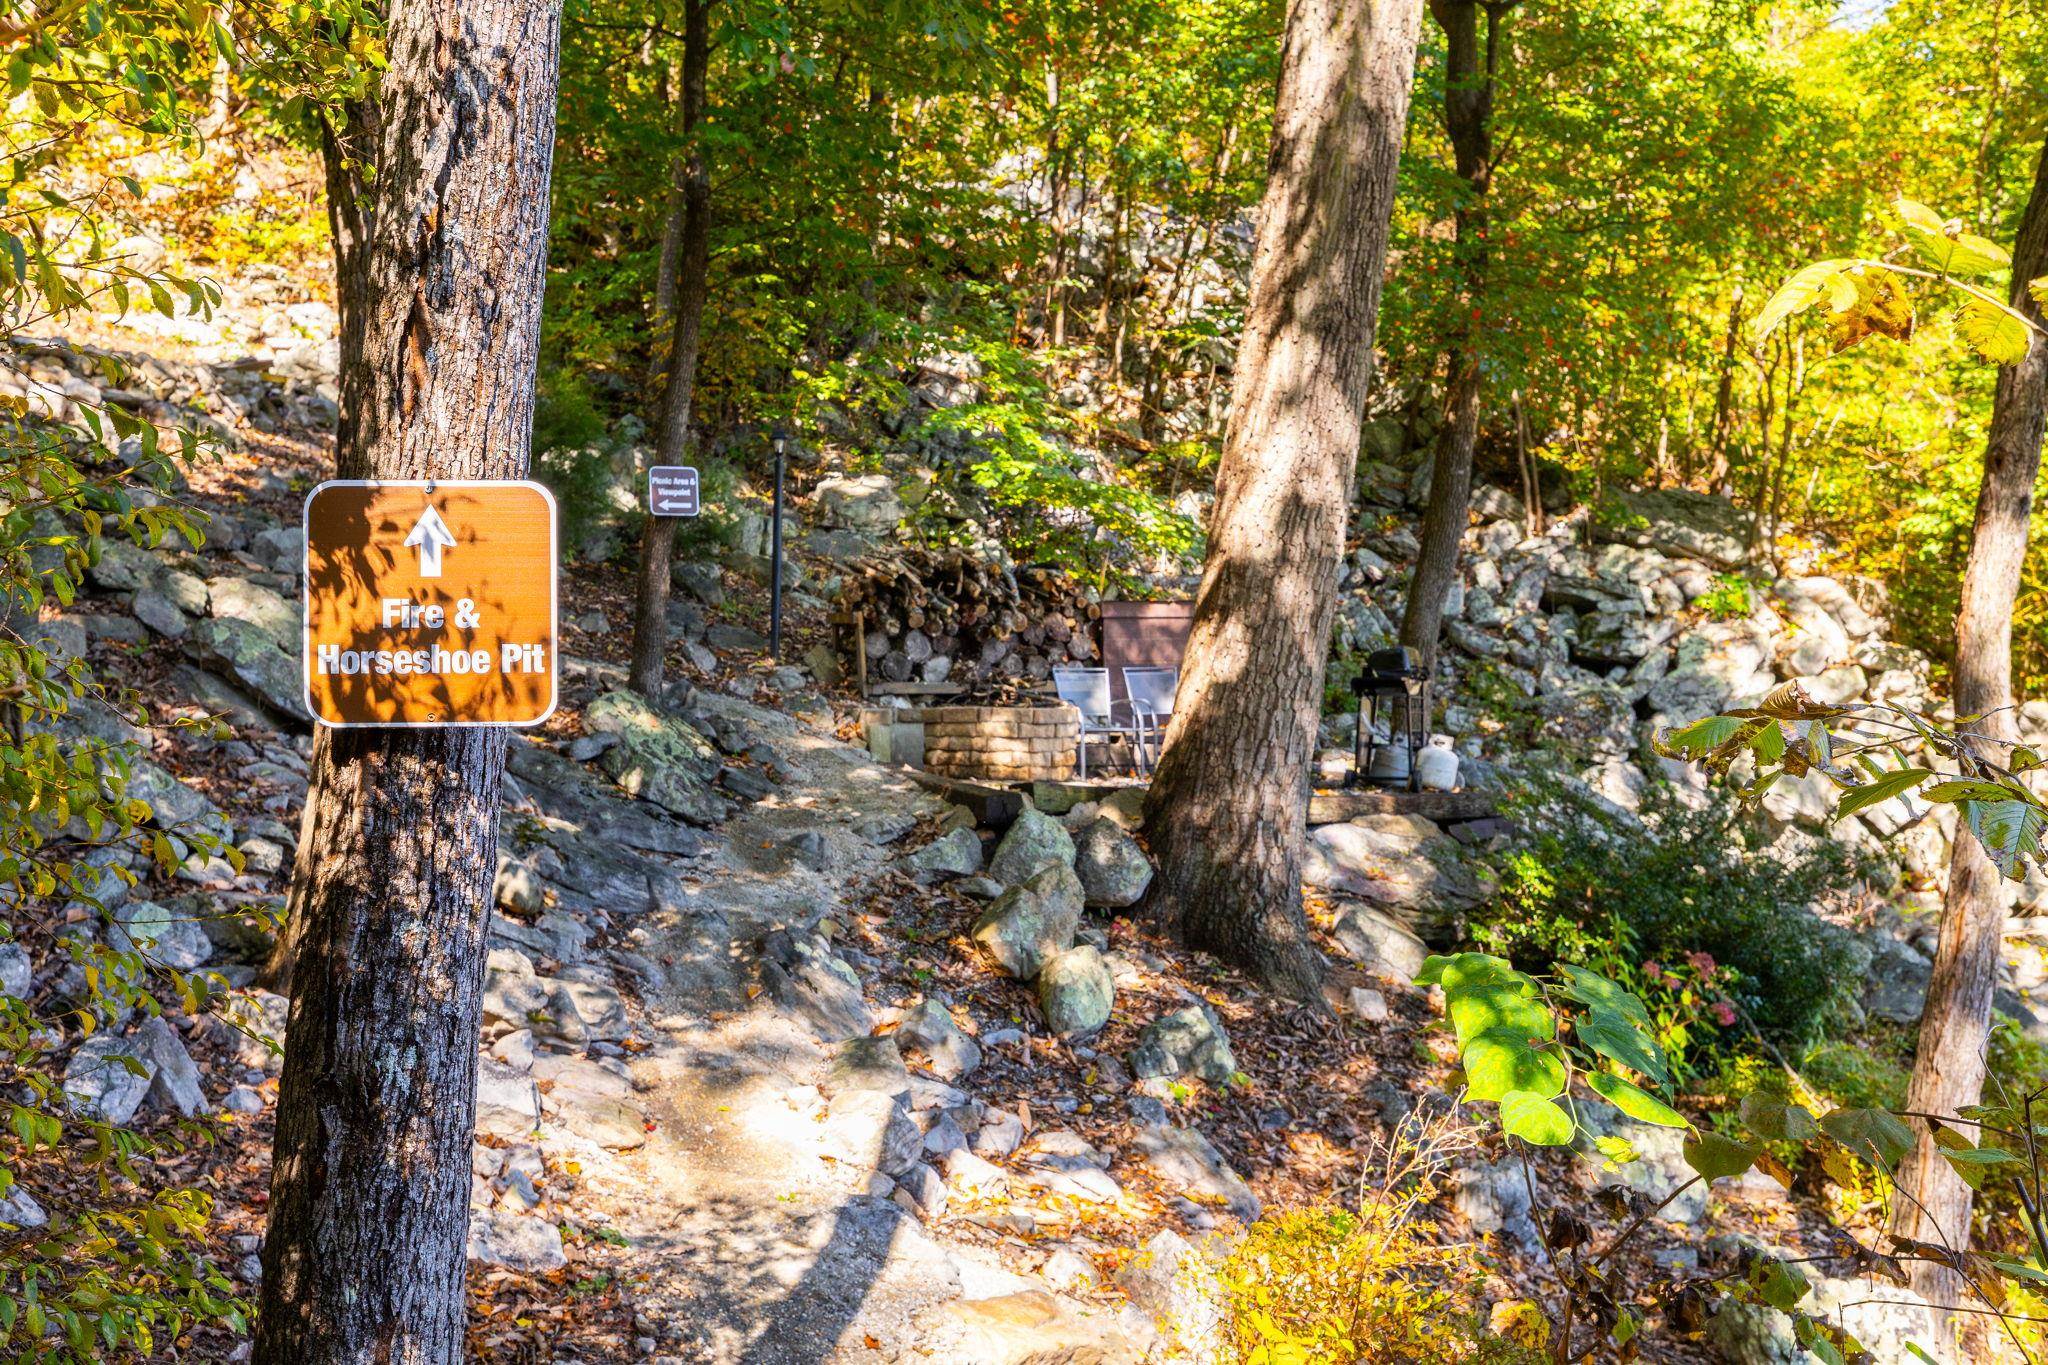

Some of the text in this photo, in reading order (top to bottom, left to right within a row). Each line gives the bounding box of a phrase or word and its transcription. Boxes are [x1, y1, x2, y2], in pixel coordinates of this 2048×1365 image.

[652, 477, 672, 485] Picnic
[673, 477, 689, 485] Area
[657, 488, 690, 497] Viewpoint
[382, 598, 480, 629] Fire &
[317, 644, 545, 675] Horseshoe Pit
